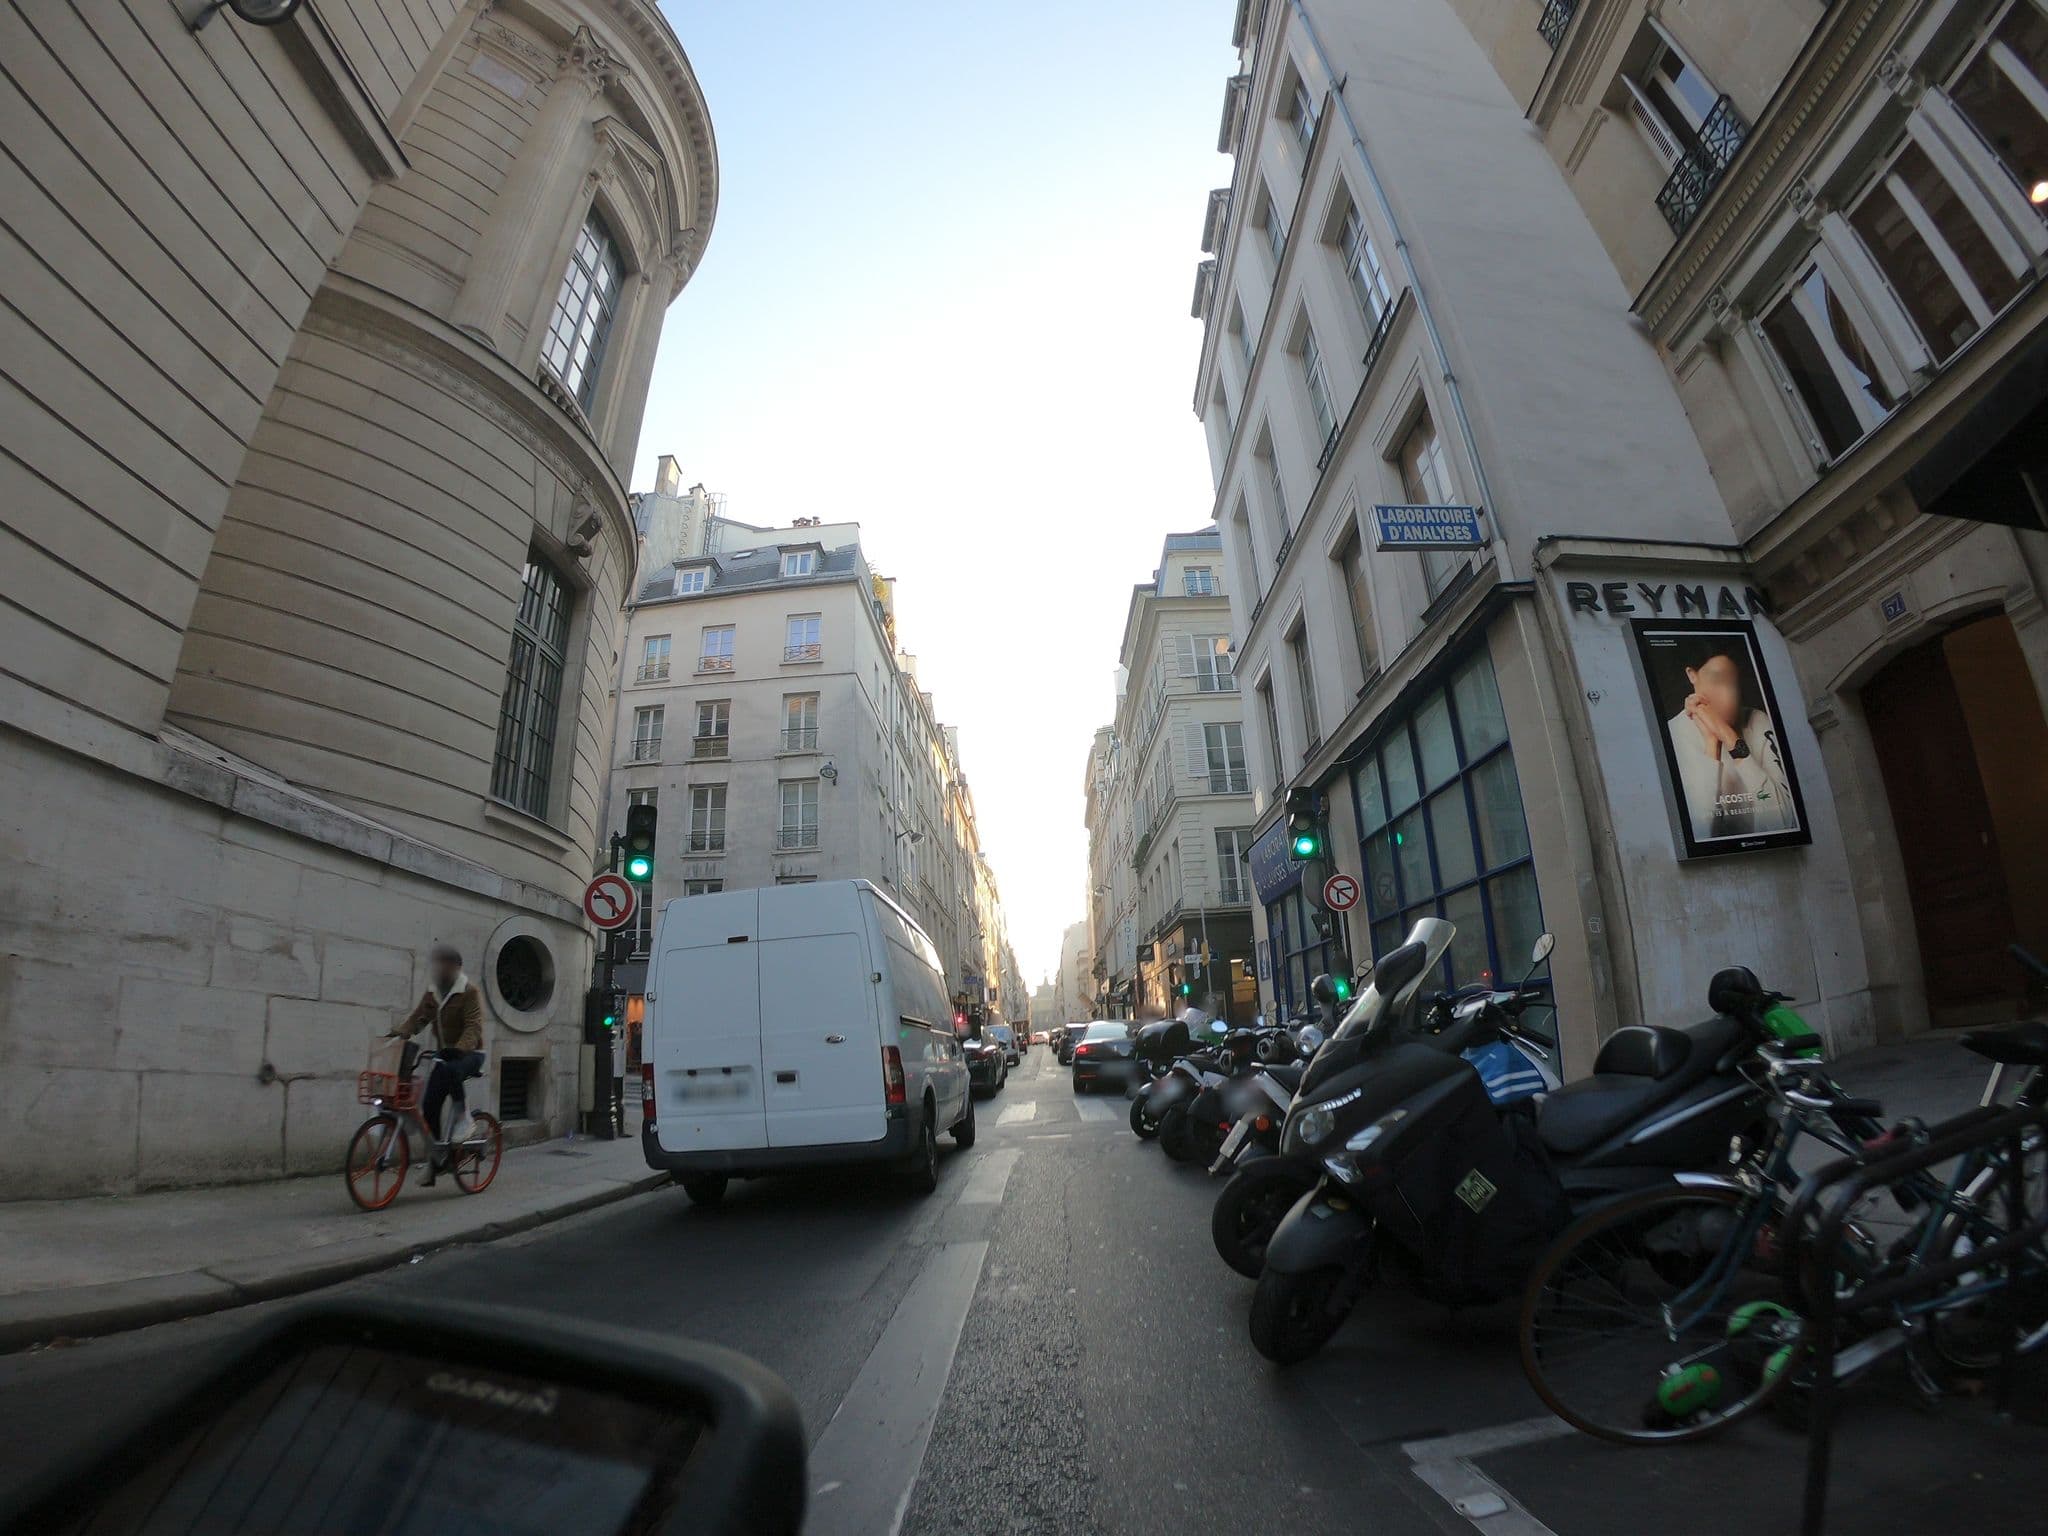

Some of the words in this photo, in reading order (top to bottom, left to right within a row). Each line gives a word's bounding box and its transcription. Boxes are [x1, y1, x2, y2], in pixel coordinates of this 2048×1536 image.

[1378, 508, 1474, 524] LABORATOIRE
[1389, 525, 1472, 541] D'ANALYSES
[1566, 581, 1769, 615] REYMAN
